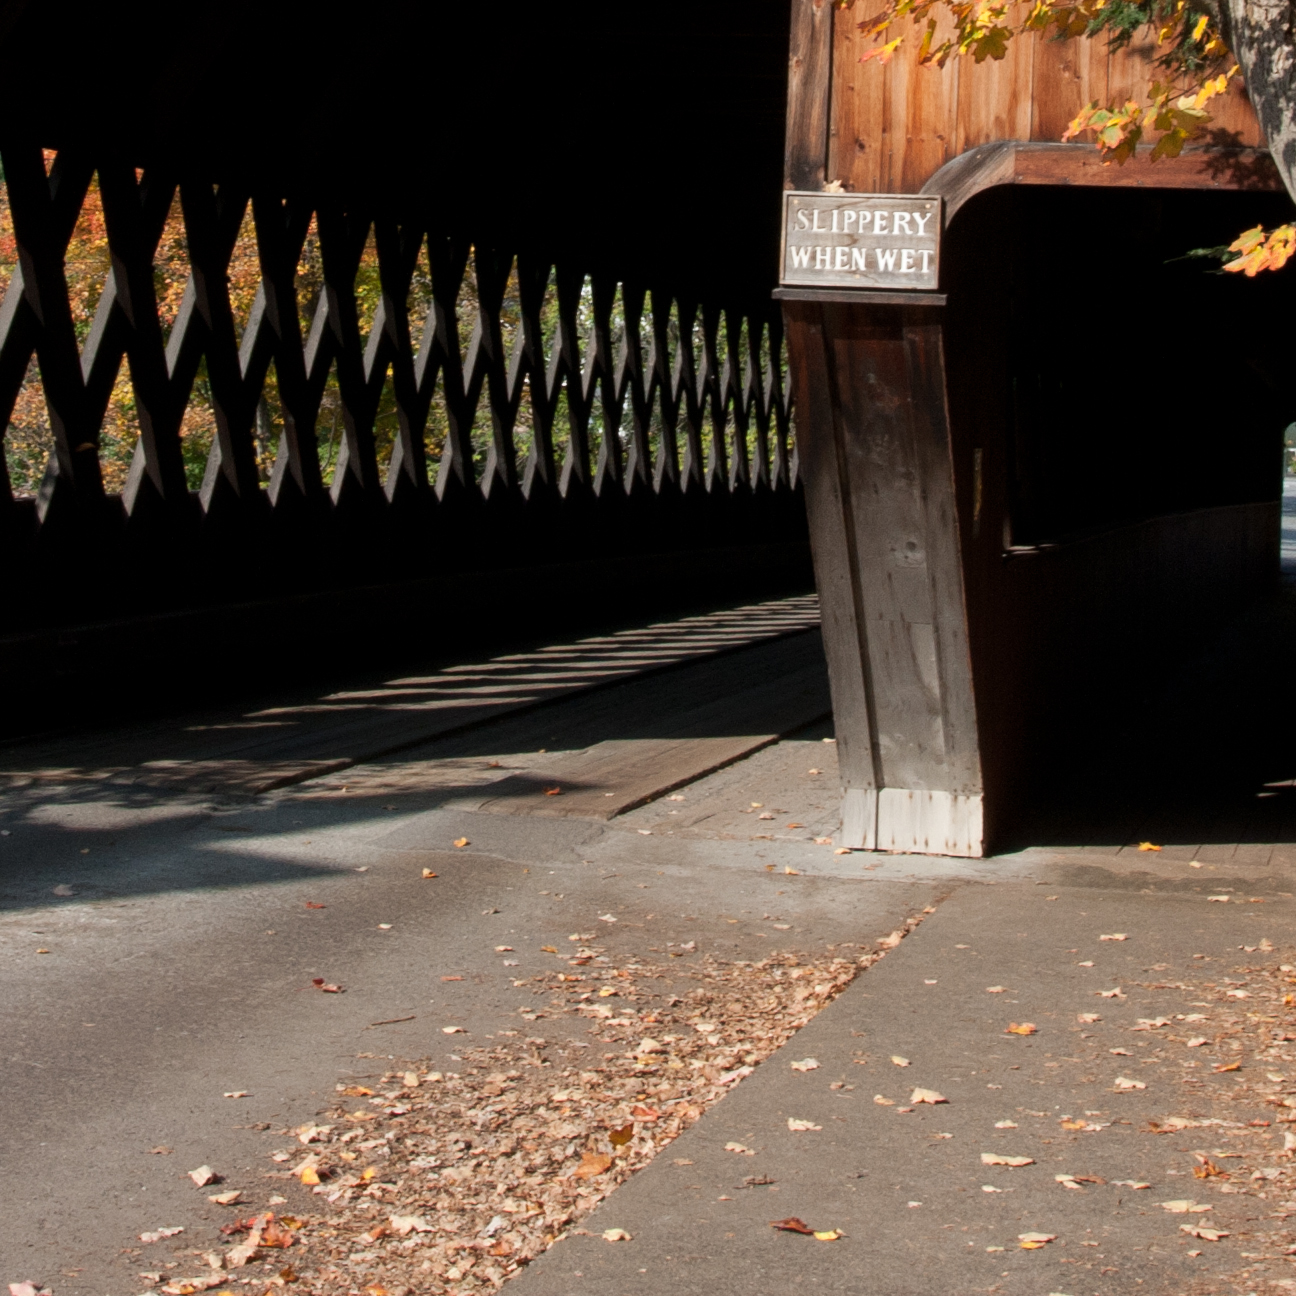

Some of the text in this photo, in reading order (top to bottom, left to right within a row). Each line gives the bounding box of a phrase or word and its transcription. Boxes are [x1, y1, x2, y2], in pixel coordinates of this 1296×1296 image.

[793, 208, 932, 236] SLIPPERY
[789, 245, 934, 273] WHEN WET
